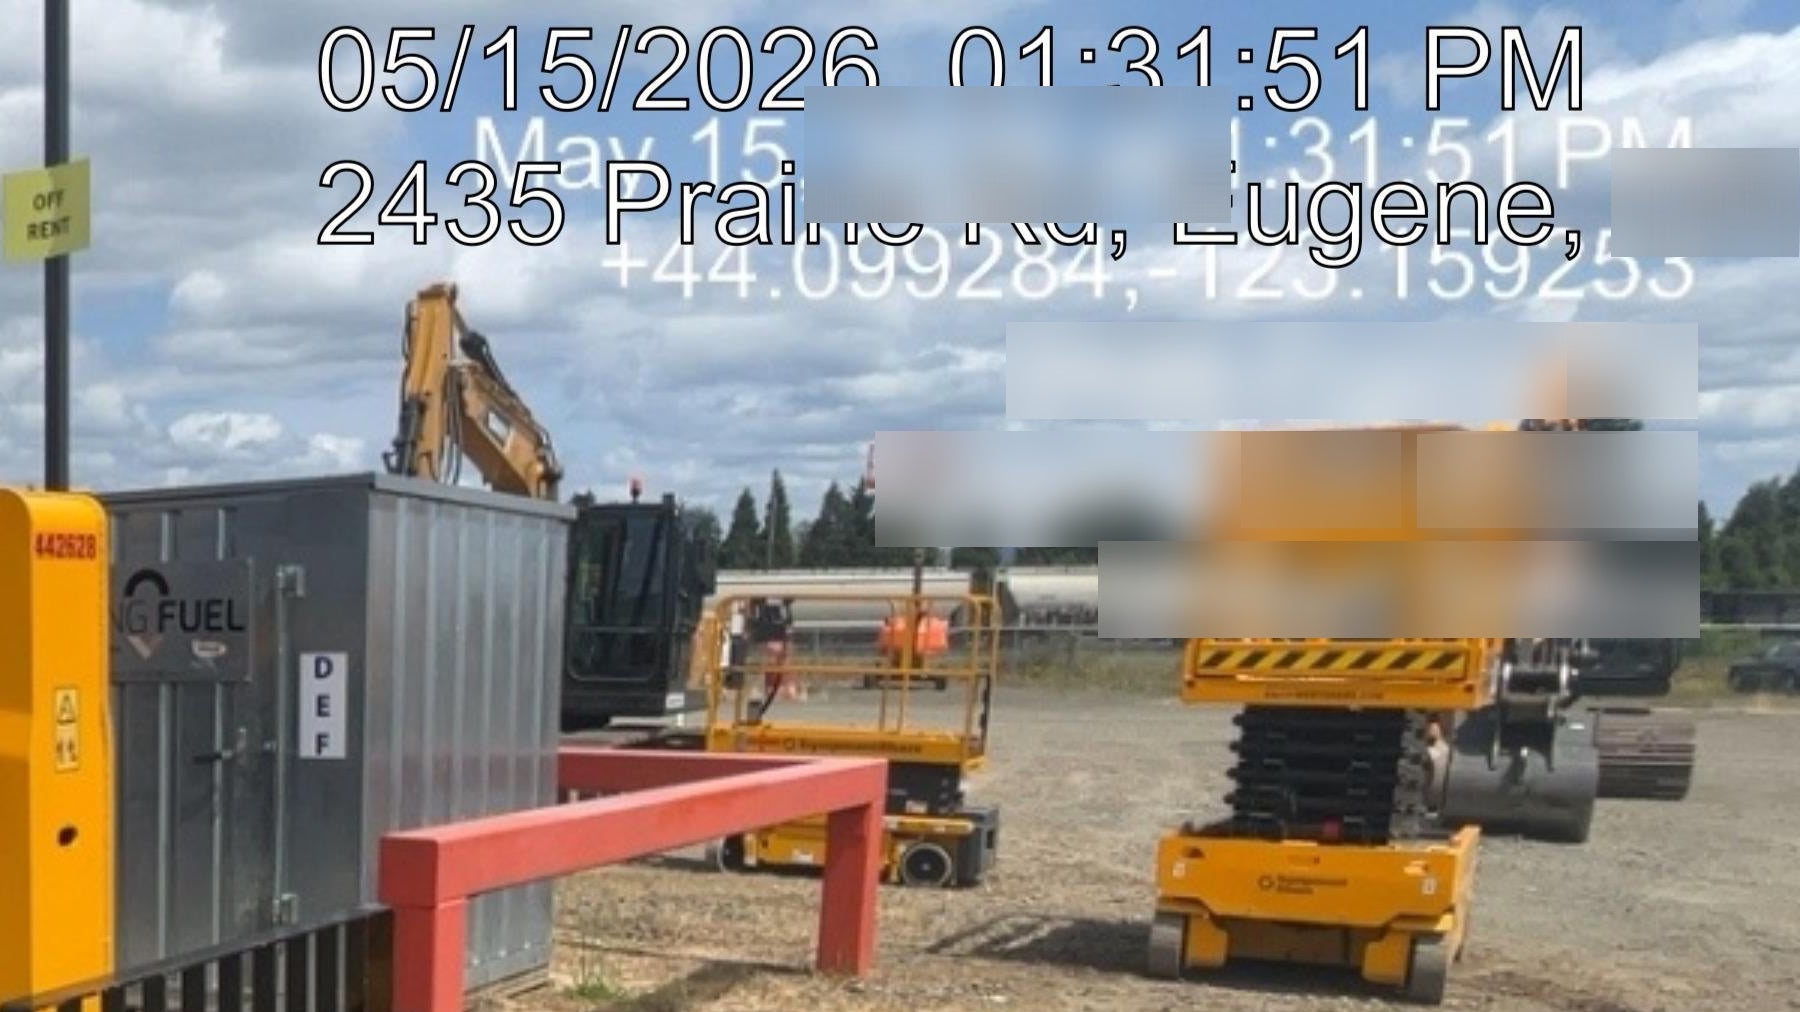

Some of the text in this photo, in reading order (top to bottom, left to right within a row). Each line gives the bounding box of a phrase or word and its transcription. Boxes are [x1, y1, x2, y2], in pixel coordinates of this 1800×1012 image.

[32, 188, 65, 211] OFF
[26, 216, 71, 241] RENT
[35, 532, 97, 561] 442628
[158, 600, 247, 633] FUEL
